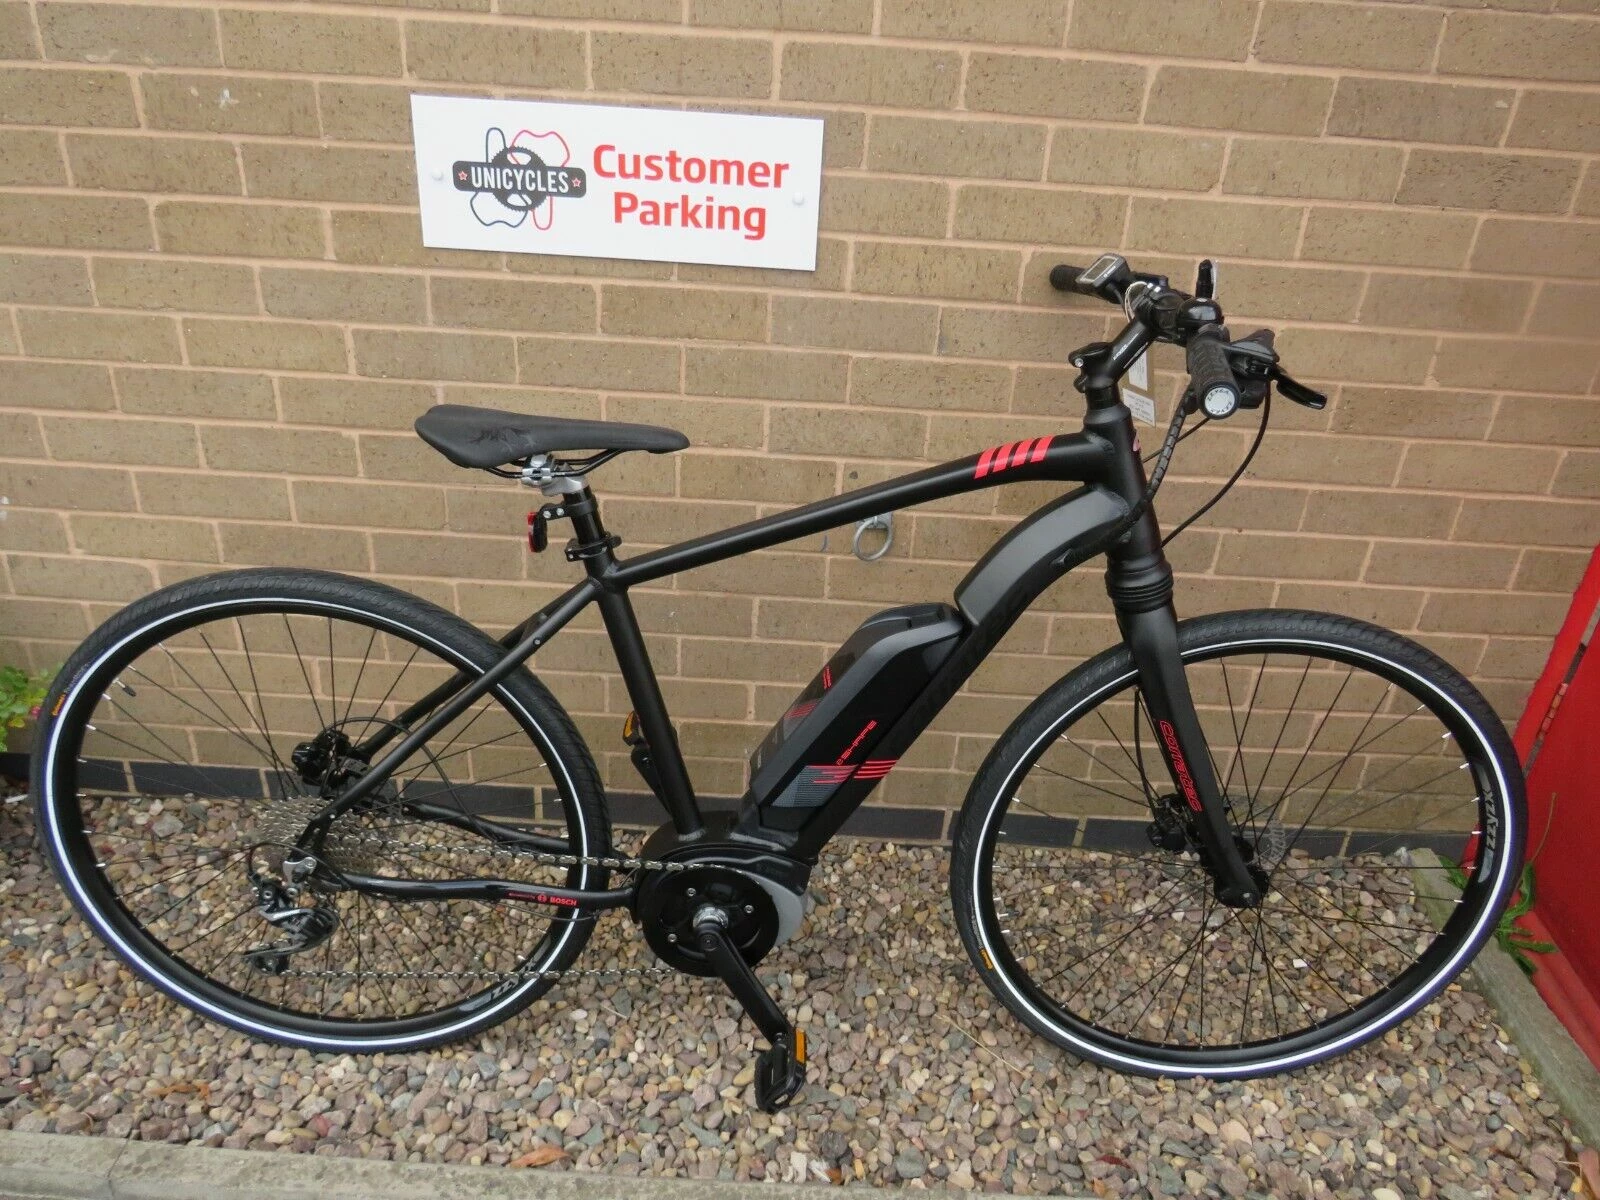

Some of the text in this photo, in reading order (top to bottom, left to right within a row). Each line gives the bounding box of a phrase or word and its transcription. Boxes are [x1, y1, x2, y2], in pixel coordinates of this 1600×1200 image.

[471, 165, 569, 194] UNICYCLES
[593, 144, 789, 189] Customer
[613, 191, 767, 241] Parking
[549, 896, 577, 906] BOSCH
